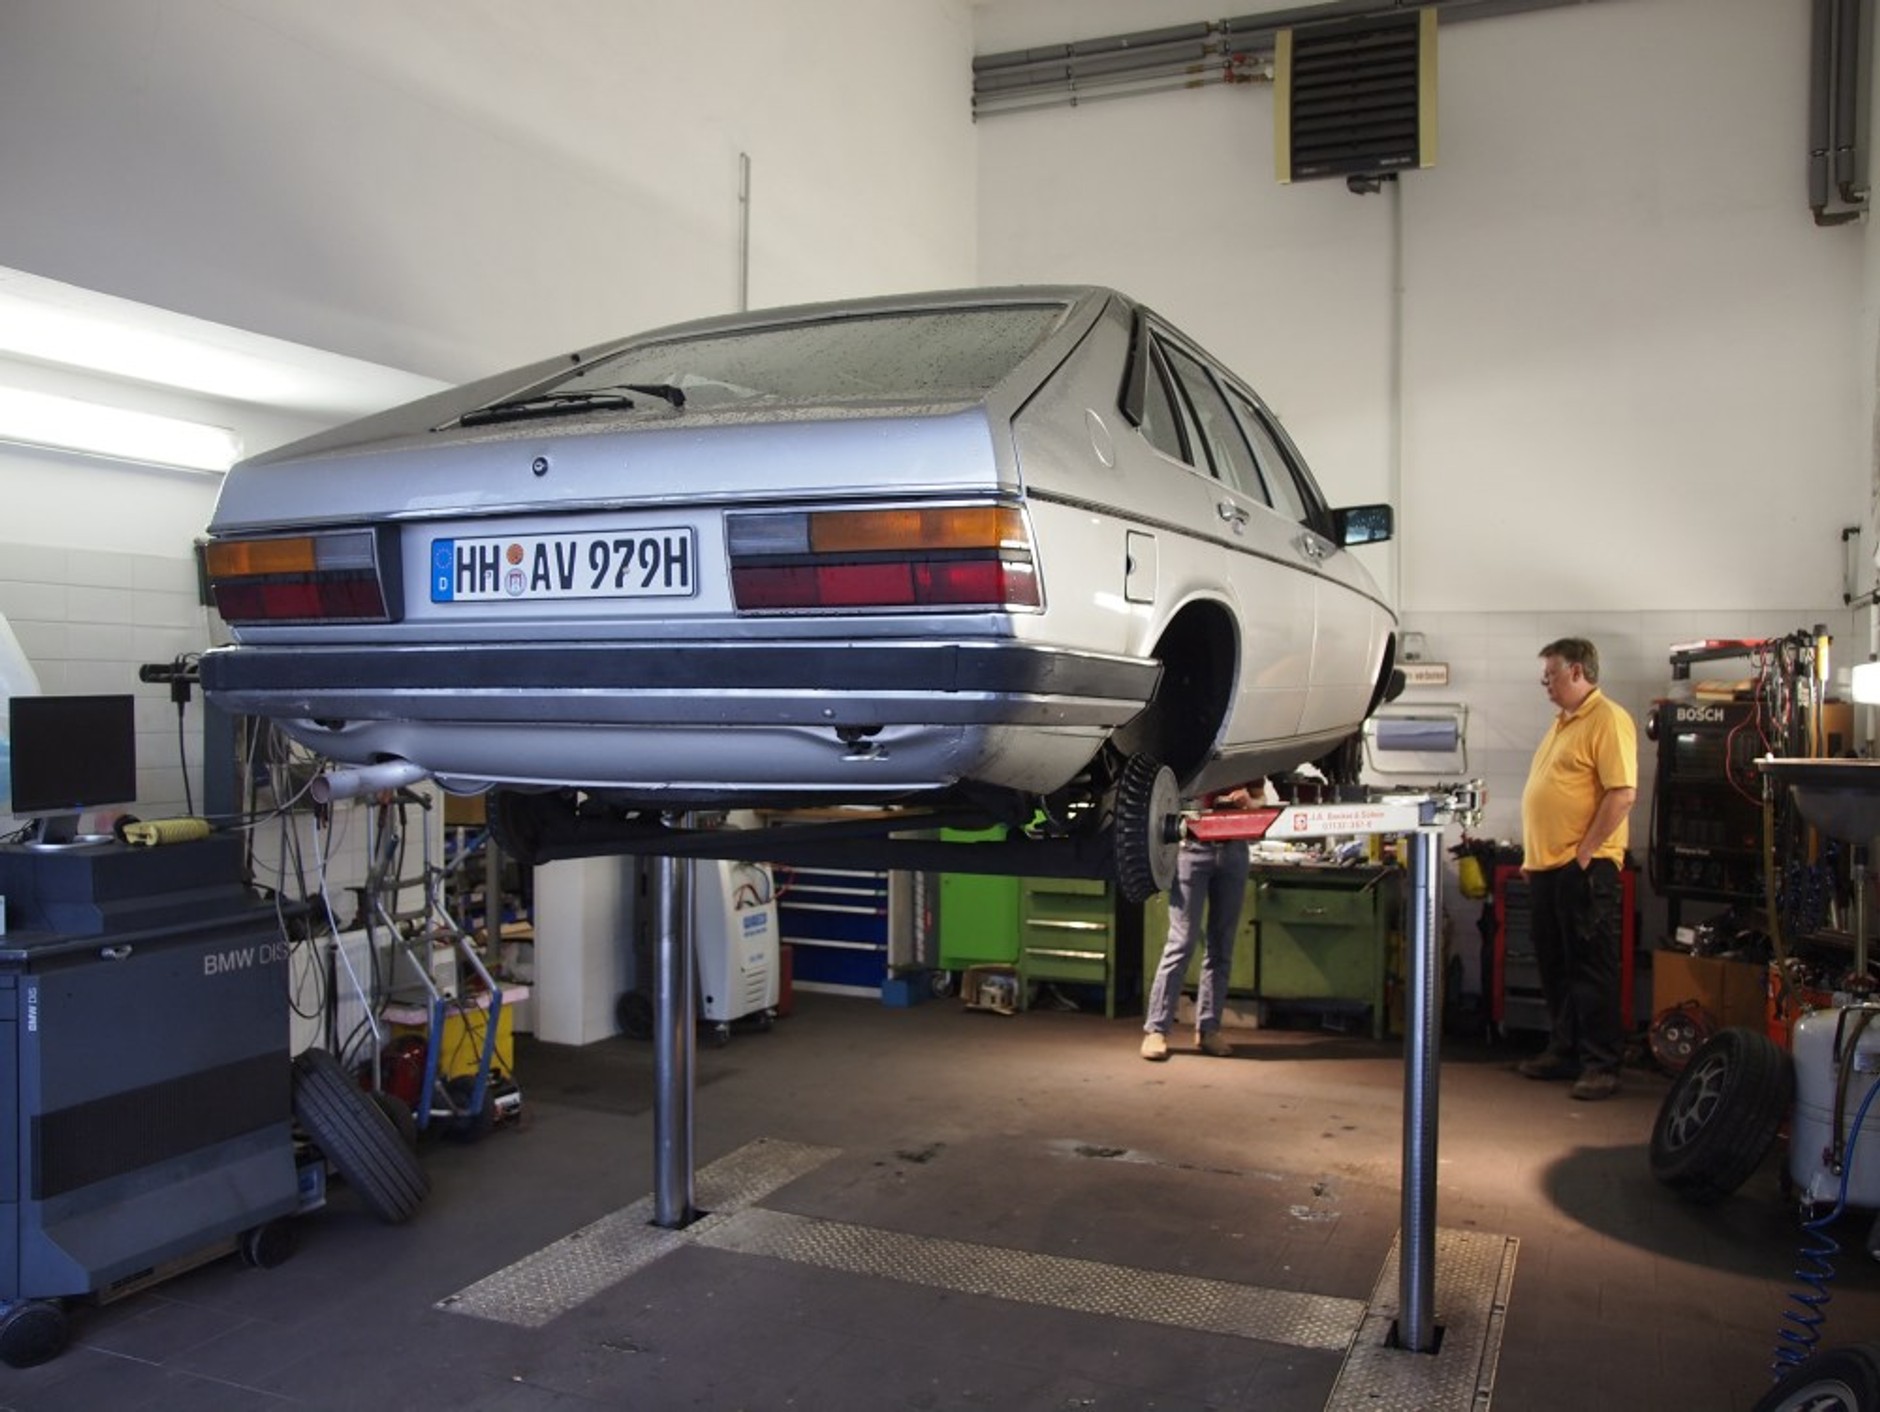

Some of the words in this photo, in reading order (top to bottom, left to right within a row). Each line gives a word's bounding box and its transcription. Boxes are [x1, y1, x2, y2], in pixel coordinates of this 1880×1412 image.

[456, 544, 500, 593] HH
[530, 541, 577, 591] AV
[589, 536, 688, 590] 979H
[438, 577, 448, 591] D
[1677, 706, 1724, 722] BOSCH
[204, 947, 255, 976] BMW
[259, 942, 289, 964] DIS
